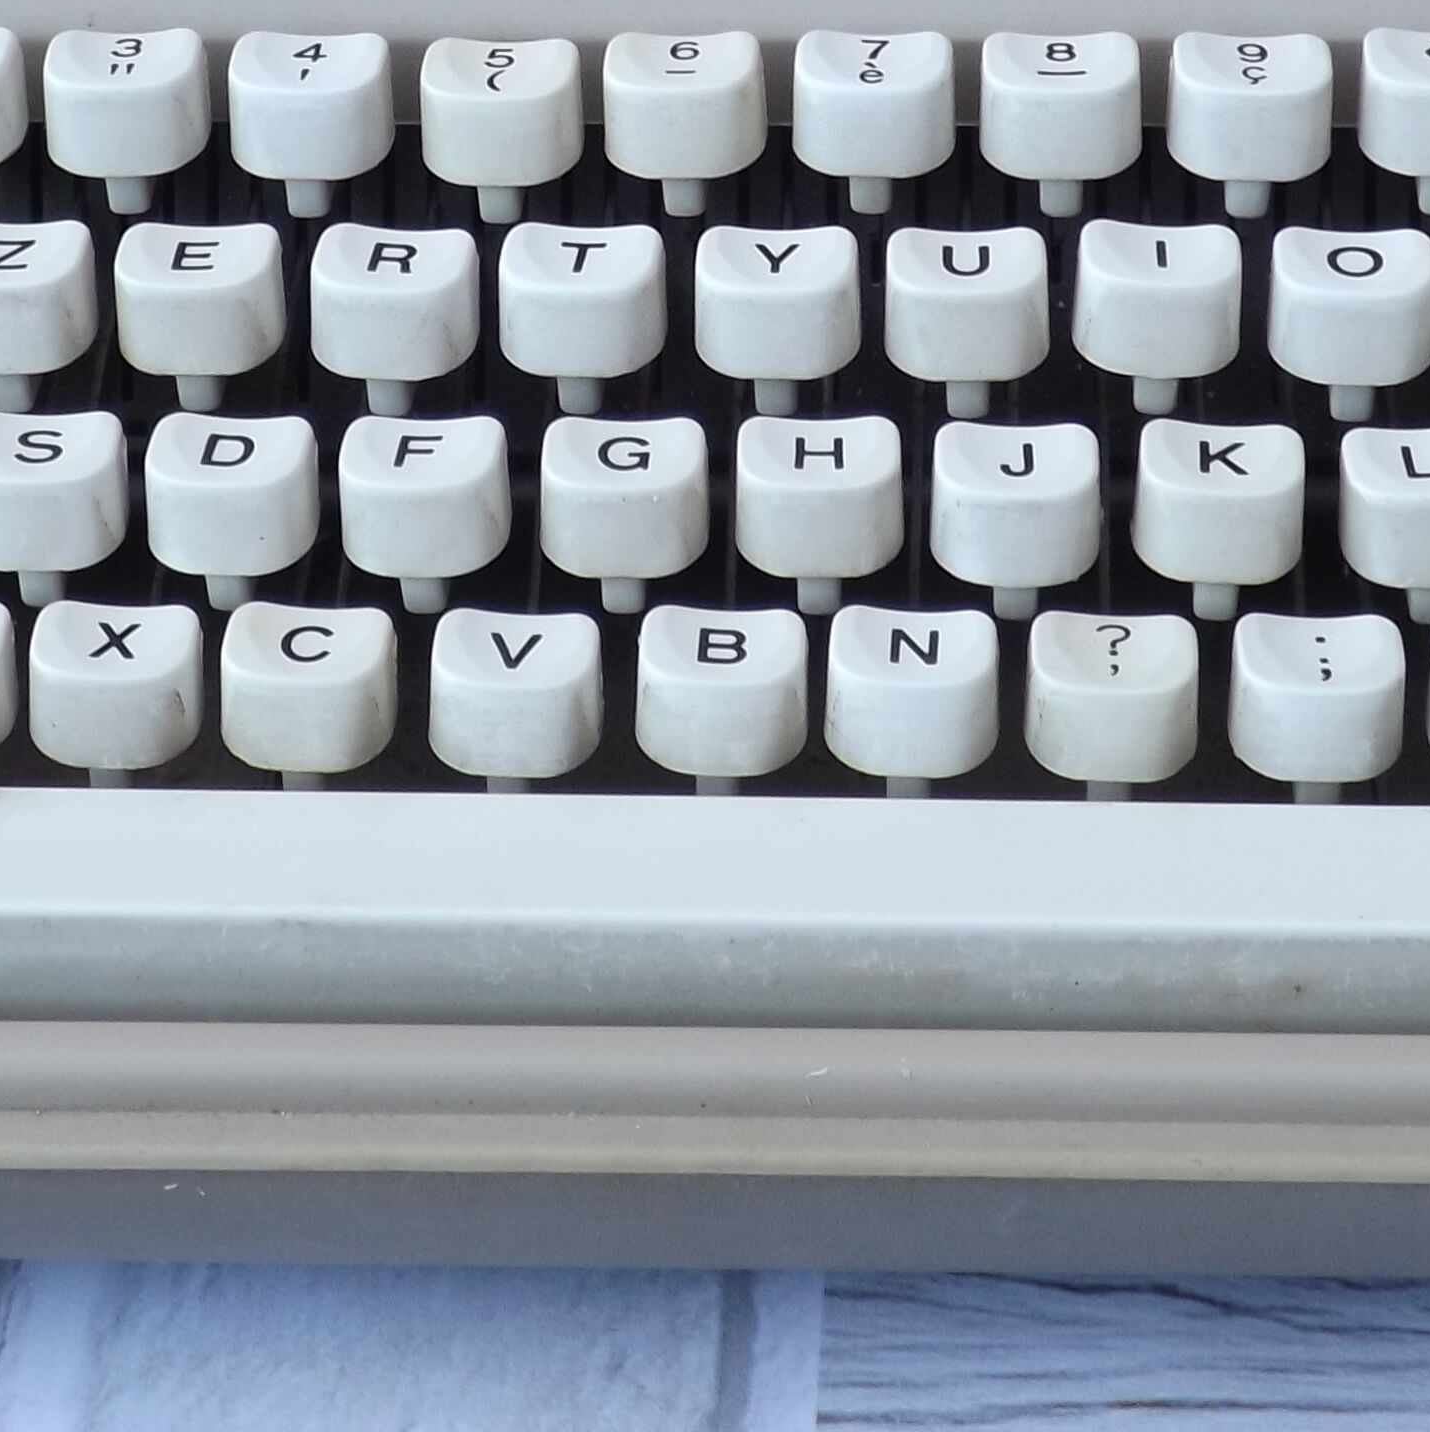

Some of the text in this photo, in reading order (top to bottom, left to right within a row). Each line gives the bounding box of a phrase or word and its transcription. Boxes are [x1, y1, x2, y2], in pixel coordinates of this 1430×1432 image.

[111, 38, 143, 58] 3
[293, 43, 327, 63] 4
[484, 48, 515, 69] 5
[669, 41, 700, 61] 6
[861, 39, 890, 60] 7
[1045, 42, 1077, 62] 8
[1236, 43, 1268, 63] 9
[486, 70, 504, 92] (
[859, 61, 884, 84] è
[1241, 66, 1267, 85] ç
[170, 241, 220, 271] E
[366, 242, 418, 274] R
[561, 241, 607, 273] T
[754, 243, 800, 274] Y
[942, 245, 990, 277] U
[1155, 240, 1168, 268] I
[1326, 246, 1384, 278] O
[14, 430, 63, 464] S
[200, 433, 255, 467] D
[393, 435, 444, 468] F
[597, 436, 651, 471] G
[794, 436, 844, 470] H
[999, 442, 1035, 478] J
[1199, 440, 1249, 476] K
[88, 621, 141, 660] X
[280, 625, 334, 663] C
[490, 631, 543, 670] V
[696, 627, 747, 665] B
[889, 628, 940, 665] N
[1095, 624, 1132, 657] ?
[1319, 657, 1332, 682] ;
